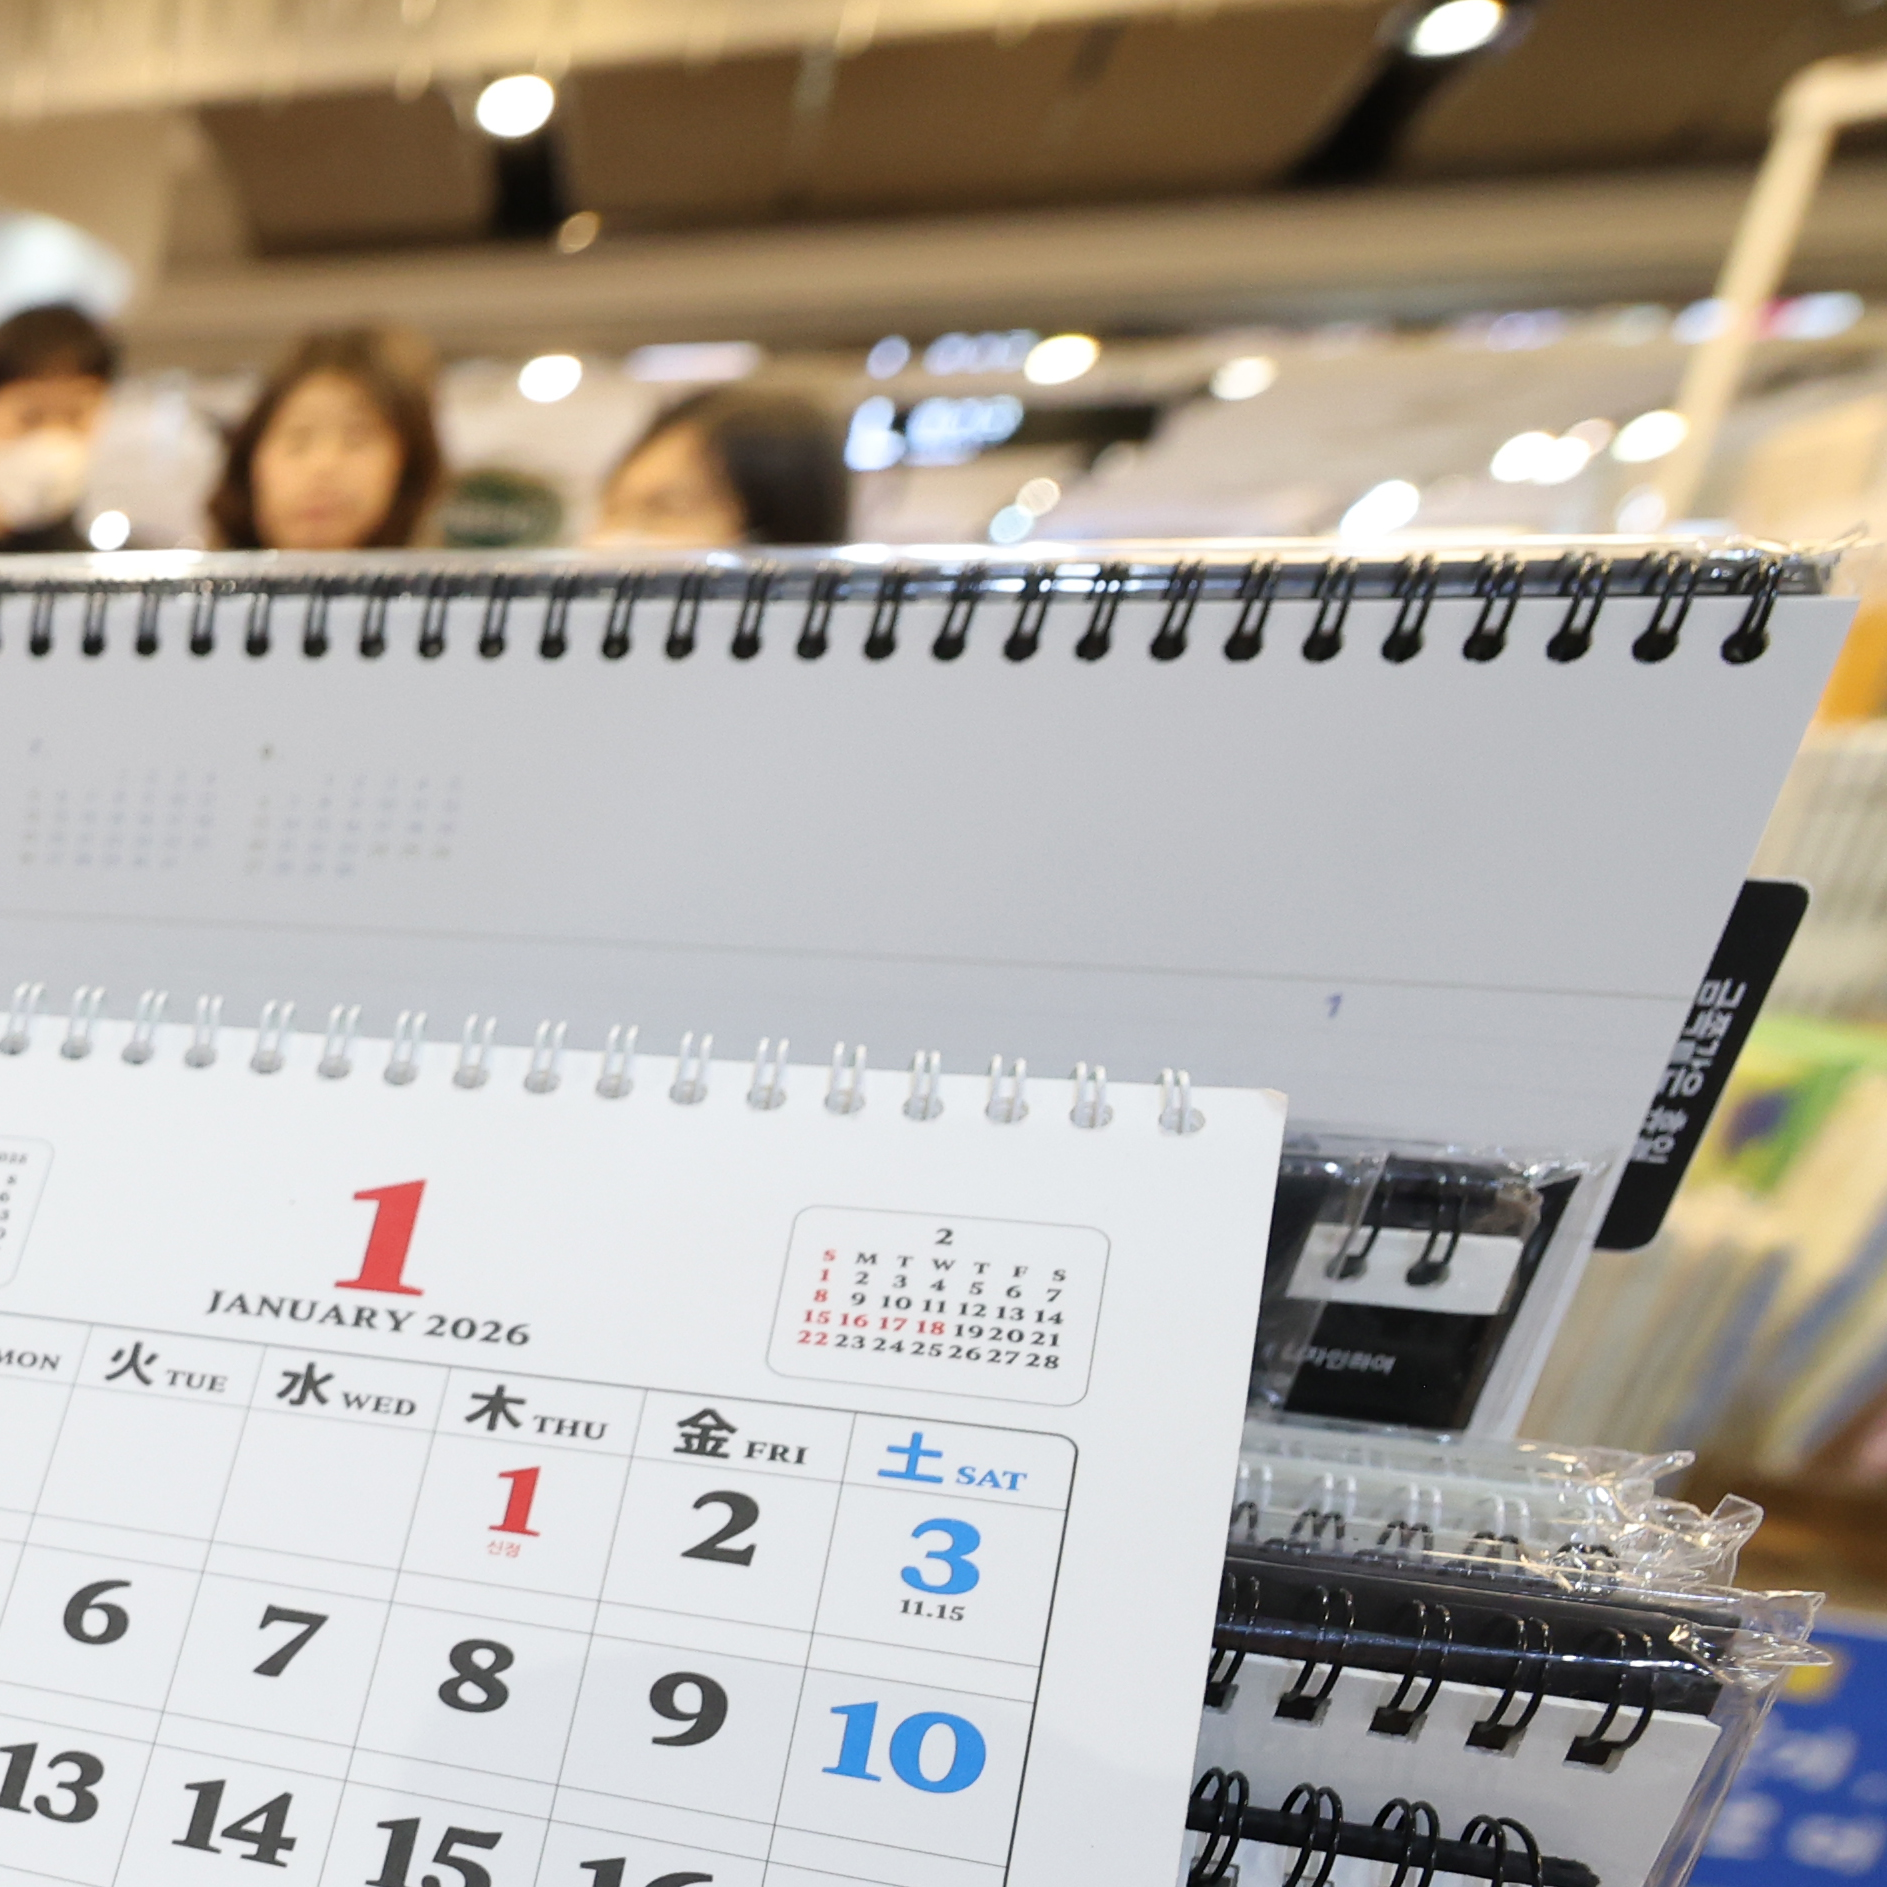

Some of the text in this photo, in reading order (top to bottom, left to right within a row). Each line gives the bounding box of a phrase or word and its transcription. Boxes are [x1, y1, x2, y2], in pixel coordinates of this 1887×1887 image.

[334, 1179, 426, 1297] 1
[935, 1228, 955, 1246] 2
[208, 1290, 530, 1346] JANUARY 2026
[797, 1330, 1060, 1369] 22 23 24 25 26 27 28
[803, 1309, 1061, 1347] 15 16 17 18 19 20 21
[104, 1341, 158, 1386] 火
[166, 1368, 229, 1394] TUE
[276, 1361, 334, 1407] 水
[342, 1392, 417, 1416] WED
[464, 1384, 526, 1432] 木
[537, 1416, 607, 1440] THU
[673, 1407, 738, 1460] 金
[745, 1441, 806, 1465] FRI
[877, 1431, 944, 1484] 土
[956, 1466, 1029, 1493] SAT
[489, 1466, 981, 1596] 1 2 3
[901, 1599, 965, 1622] 11.15
[62, 1579, 132, 1646] 6
[252, 1604, 329, 1678] 7
[437, 1638, 515, 1714] 8
[648, 1671, 729, 1748] 9
[822, 1701, 987, 1794] 10
[171, 1779, 297, 1868] 14
